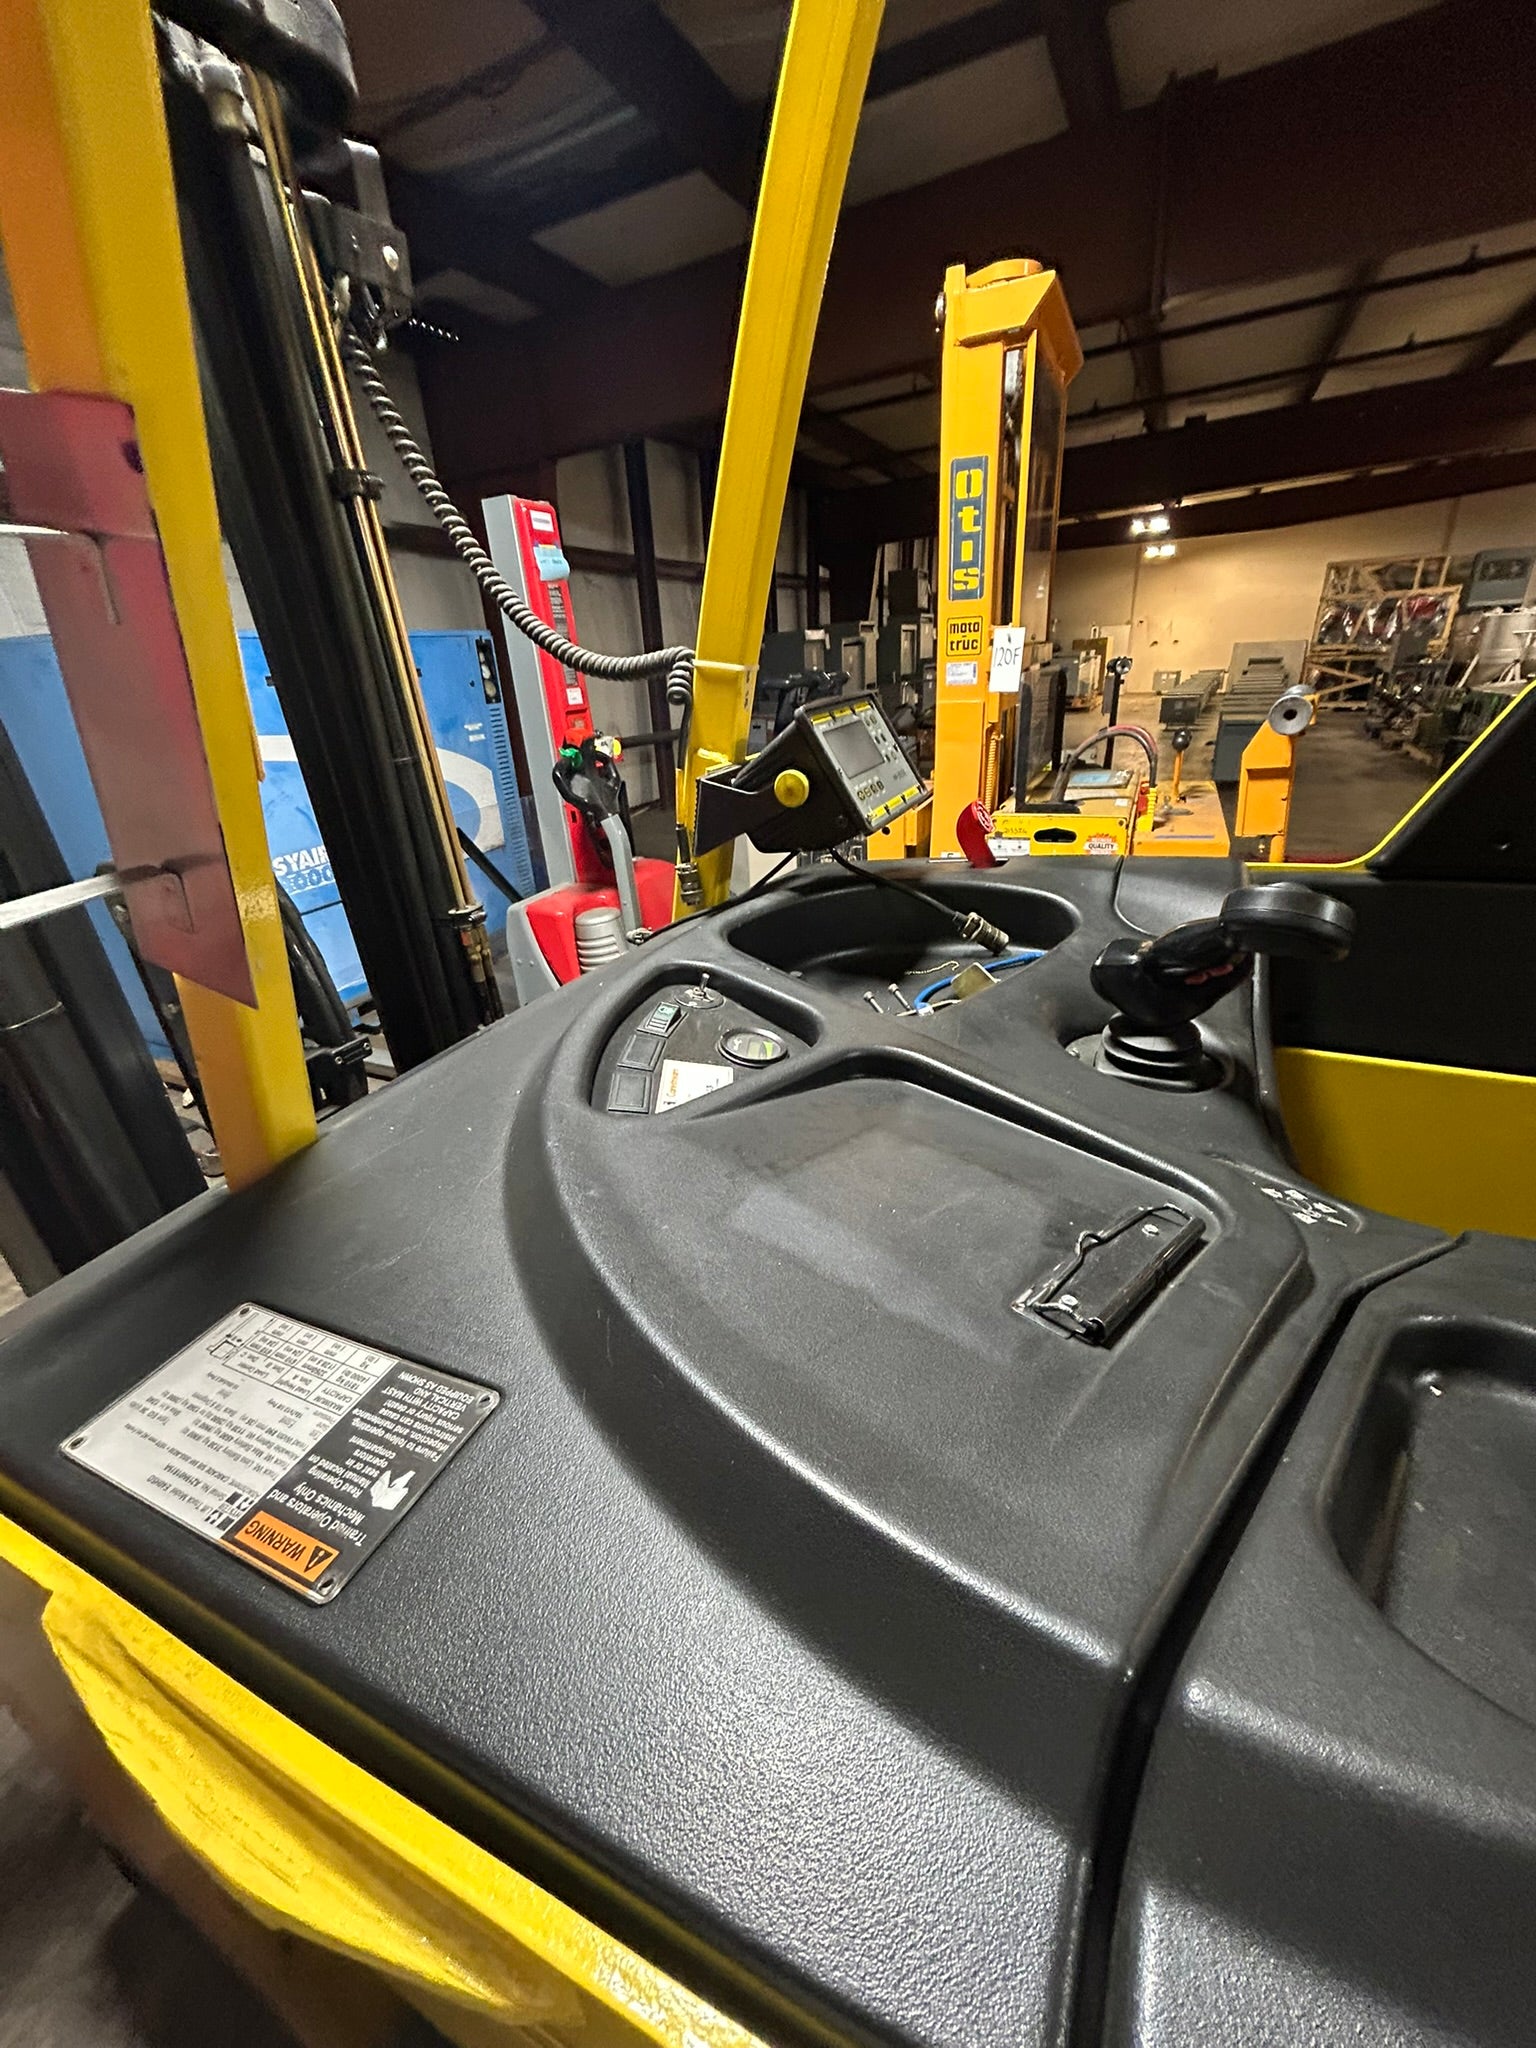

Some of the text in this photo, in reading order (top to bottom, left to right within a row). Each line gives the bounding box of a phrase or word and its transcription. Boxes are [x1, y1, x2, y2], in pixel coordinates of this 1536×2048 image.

[950, 622, 979, 634] moto
[950, 639, 978, 651] truc
[993, 646, 1021, 668] 120F
[1088, 843, 1115, 851] QUALITY
[334, 1375, 347, 1383] kg
[397, 1371, 475, 1403] EQUIPPED AS SHOWN
[293, 1386, 310, 1395] Load
[320, 1387, 353, 1403] CAPACITY
[312, 1395, 344, 1411] MAXIMUM
[381, 1385, 461, 1420] CAPACITY WITH MAST
[412, 1386, 468, 1412] VERTICAL AND
[350, 1407, 396, 1430] maintenance
[378, 1407, 401, 1420] cause
[382, 1398, 464, 1434] serious injury or death!
[398, 1415, 414, 1425] can
[392, 1424, 410, 1436] and
[348, 1433, 398, 1460] compartment
[381, 1432, 408, 1447] follow
[404, 1441, 417, 1450] to
[351, 1446, 390, 1469] operators
[412, 1444, 442, 1462] Failure
[307, 1453, 371, 1488] Manual located on
[352, 1461, 364, 1470] or
[361, 1465, 380, 1478] seat
[305, 1464, 363, 1498] Read Operating
[184, 1496, 203, 1510] Truck
[290, 1480, 366, 1526] Mechanics Only
[265, 1488, 369, 1547] Trained Operators and
[242, 1518, 308, 1562] WARNING
